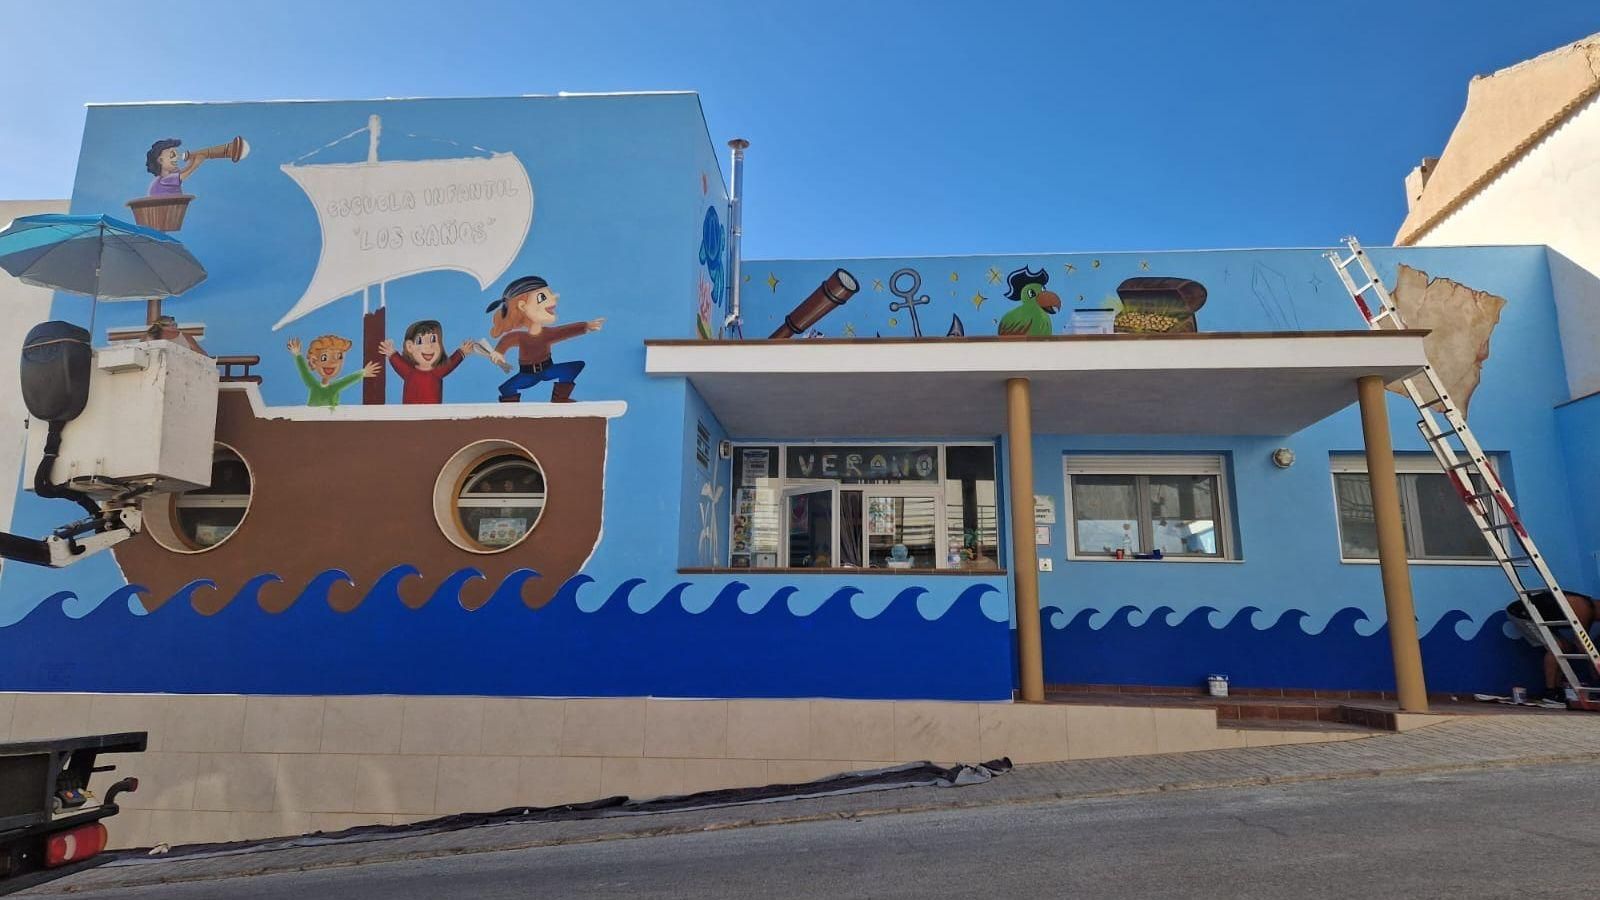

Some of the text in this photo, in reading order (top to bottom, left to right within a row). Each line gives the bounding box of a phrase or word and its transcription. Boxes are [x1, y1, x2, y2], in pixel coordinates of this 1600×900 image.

[328, 178, 519, 217] ESCUELA INFANTIL
[798, 453, 933, 477] VERANO
